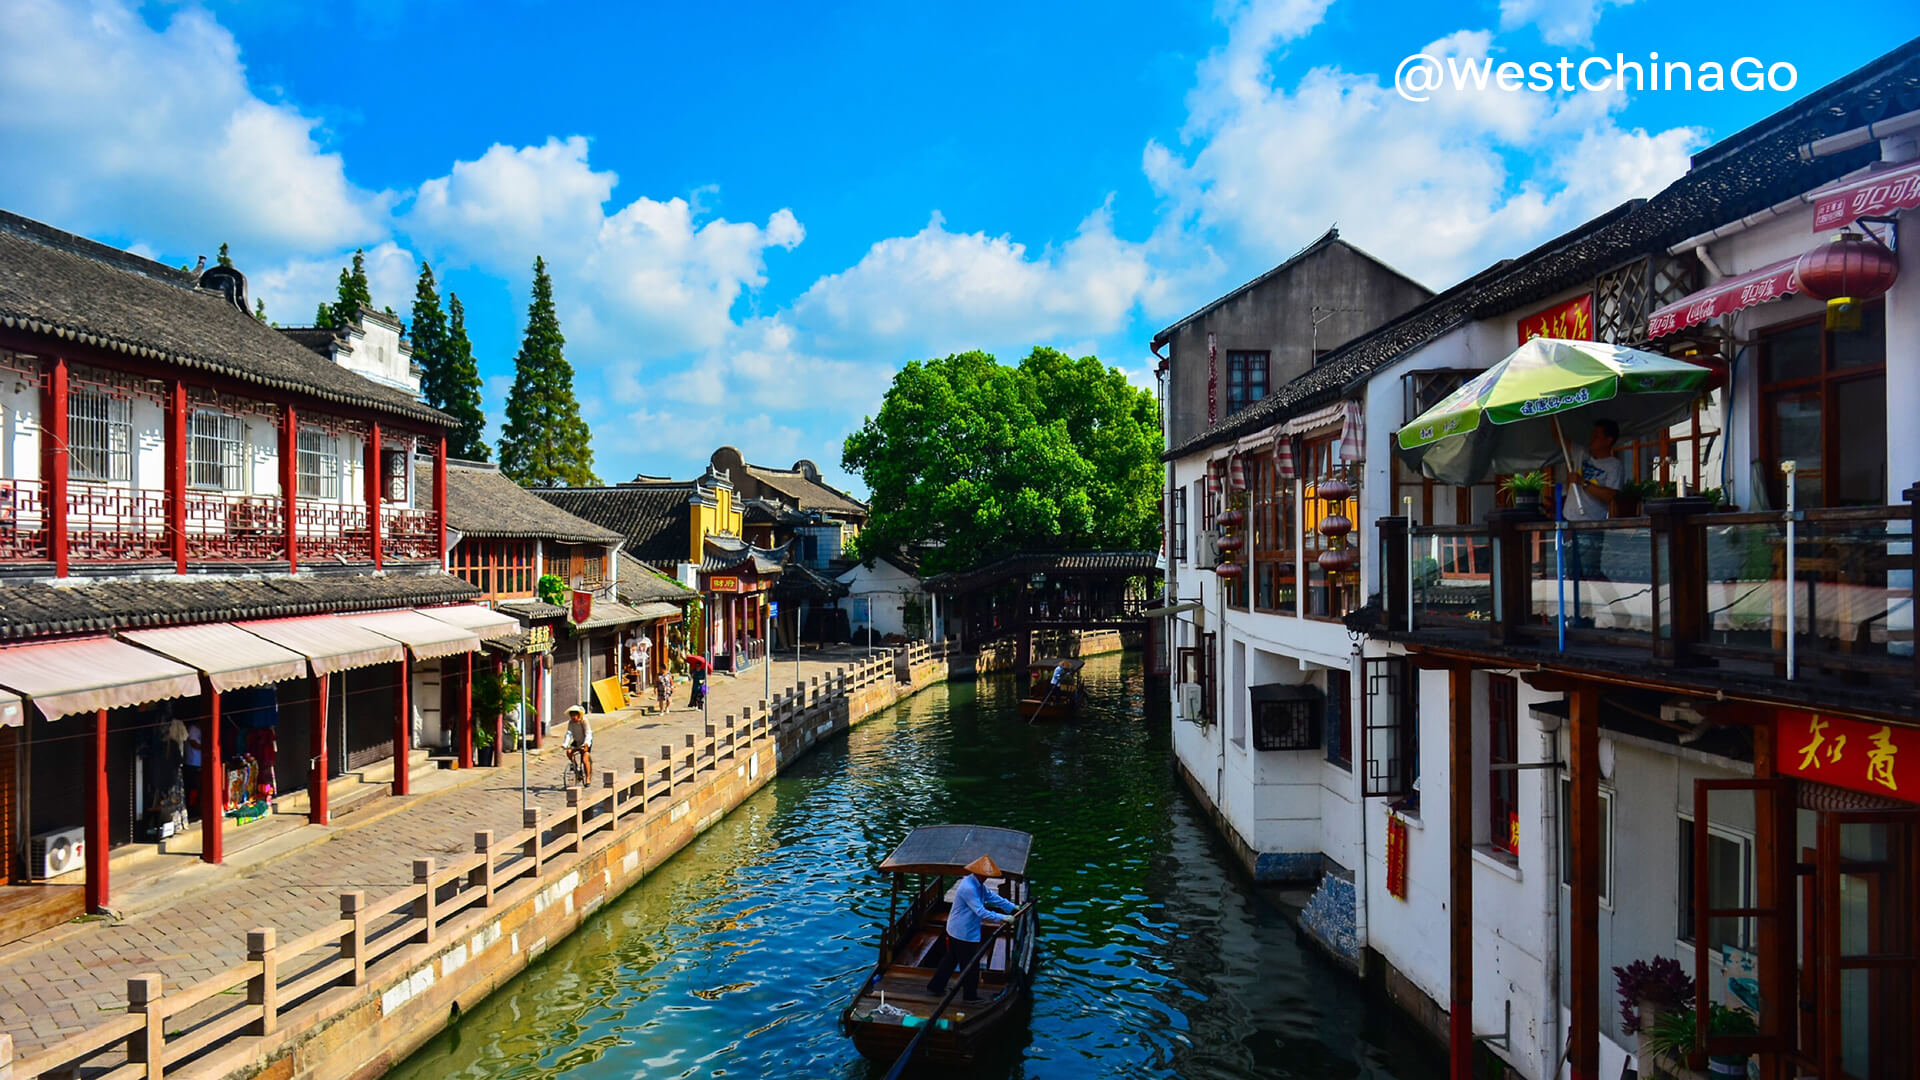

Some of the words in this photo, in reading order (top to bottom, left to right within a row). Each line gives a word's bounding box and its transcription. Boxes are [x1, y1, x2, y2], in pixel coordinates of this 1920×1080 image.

[1852, 174, 1920, 215] 可口可乐
[1741, 278, 1777, 304] 可口可乐
[1648, 313, 1675, 334] 可口可乐
[1520, 388, 1590, 416] 健康好心情
[1797, 713, 1899, 792] 知青
